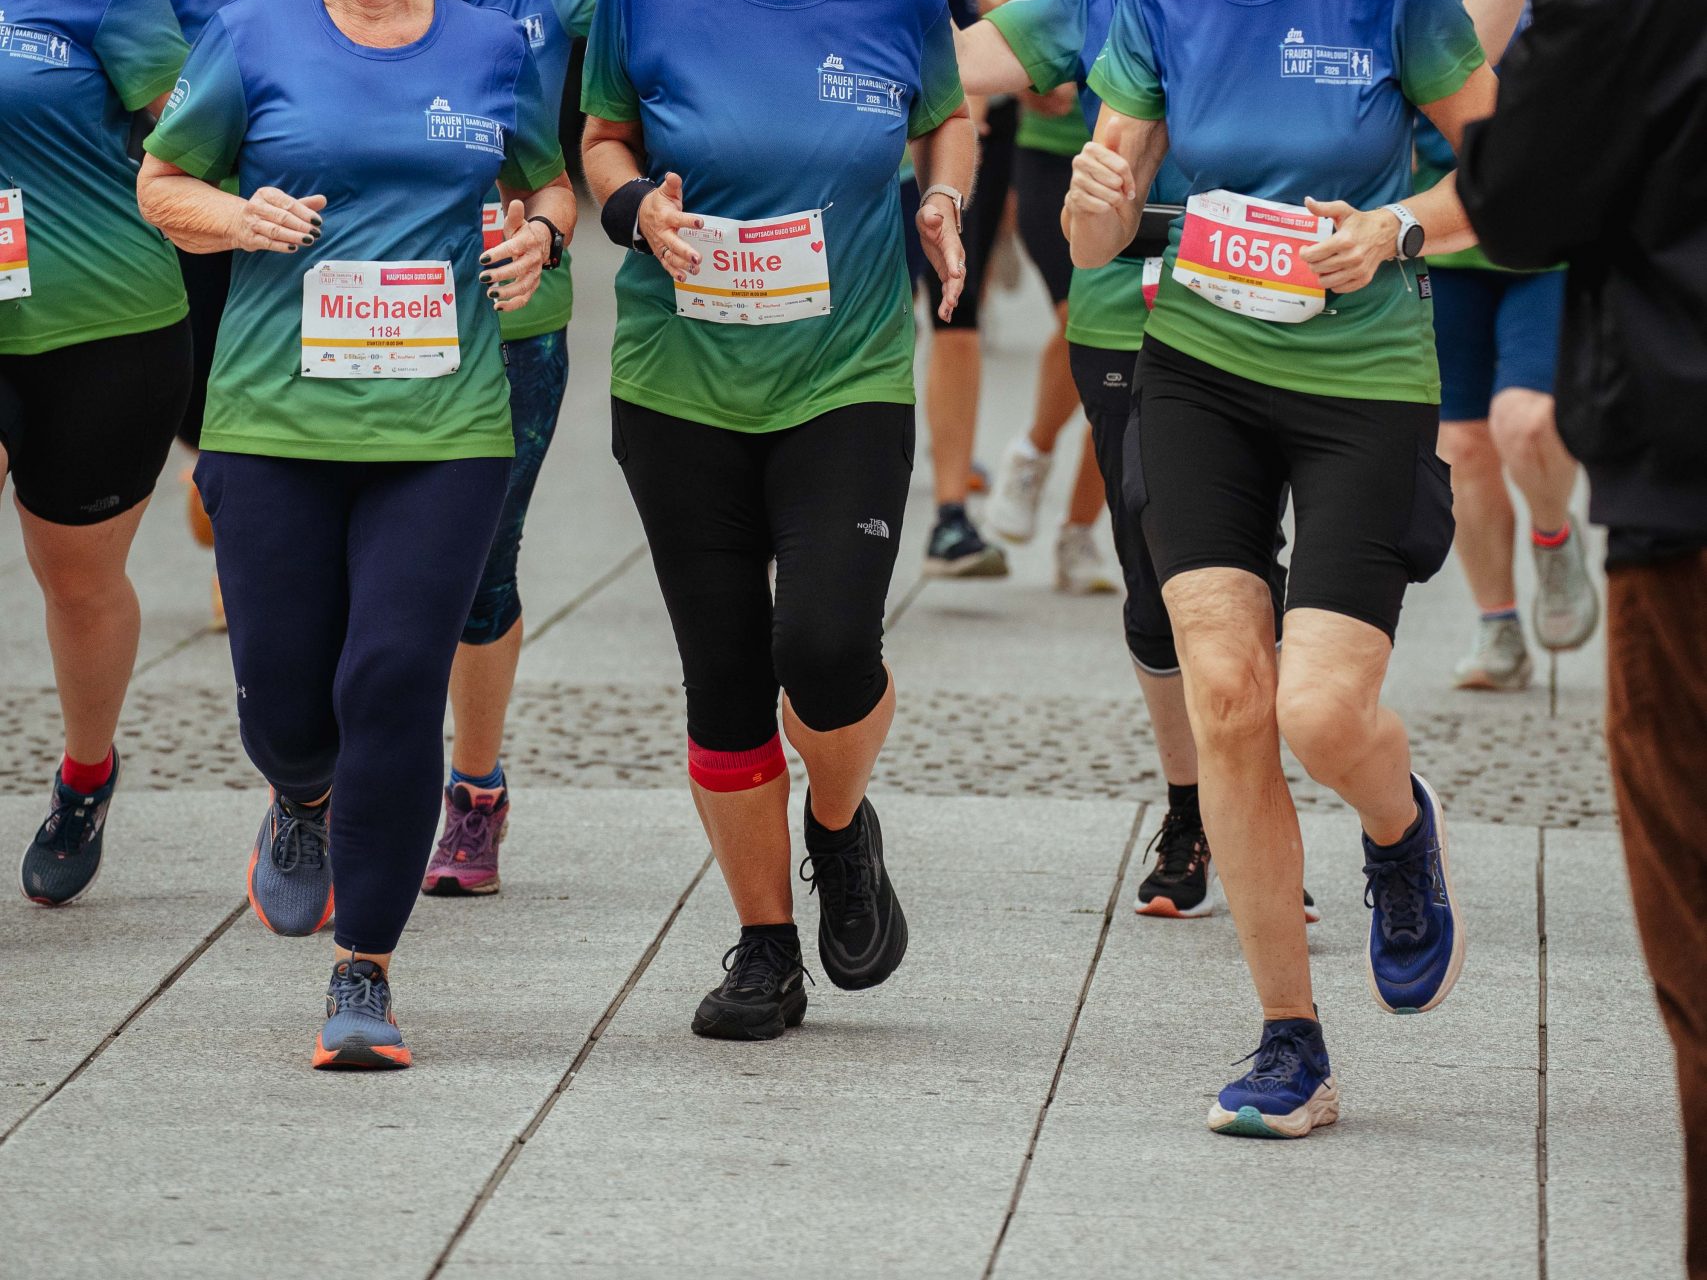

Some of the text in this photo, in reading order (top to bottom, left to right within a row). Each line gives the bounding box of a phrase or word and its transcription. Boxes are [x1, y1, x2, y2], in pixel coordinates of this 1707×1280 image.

[15, 29, 48, 42] SAARLOUIS
[826, 54, 843, 65] dm
[1284, 49, 1313, 59] FRAUEN
[1284, 60, 1313, 73] LAUF
[823, 74, 854, 87] FRAUEN
[858, 78, 887, 91] SAARLOUIS
[823, 85, 853, 100] LAUF
[431, 115, 462, 126] FRAUEN
[465, 118, 494, 130] SAARLOUIS
[431, 125, 462, 138] LAUF
[1208, 229, 1293, 277] 1656
[712, 249, 782, 273] Silke
[732, 278, 765, 289] 1419
[320, 294, 443, 319] Michaela
[369, 326, 401, 338] 1184
[857, 522, 882, 531] NORTH
